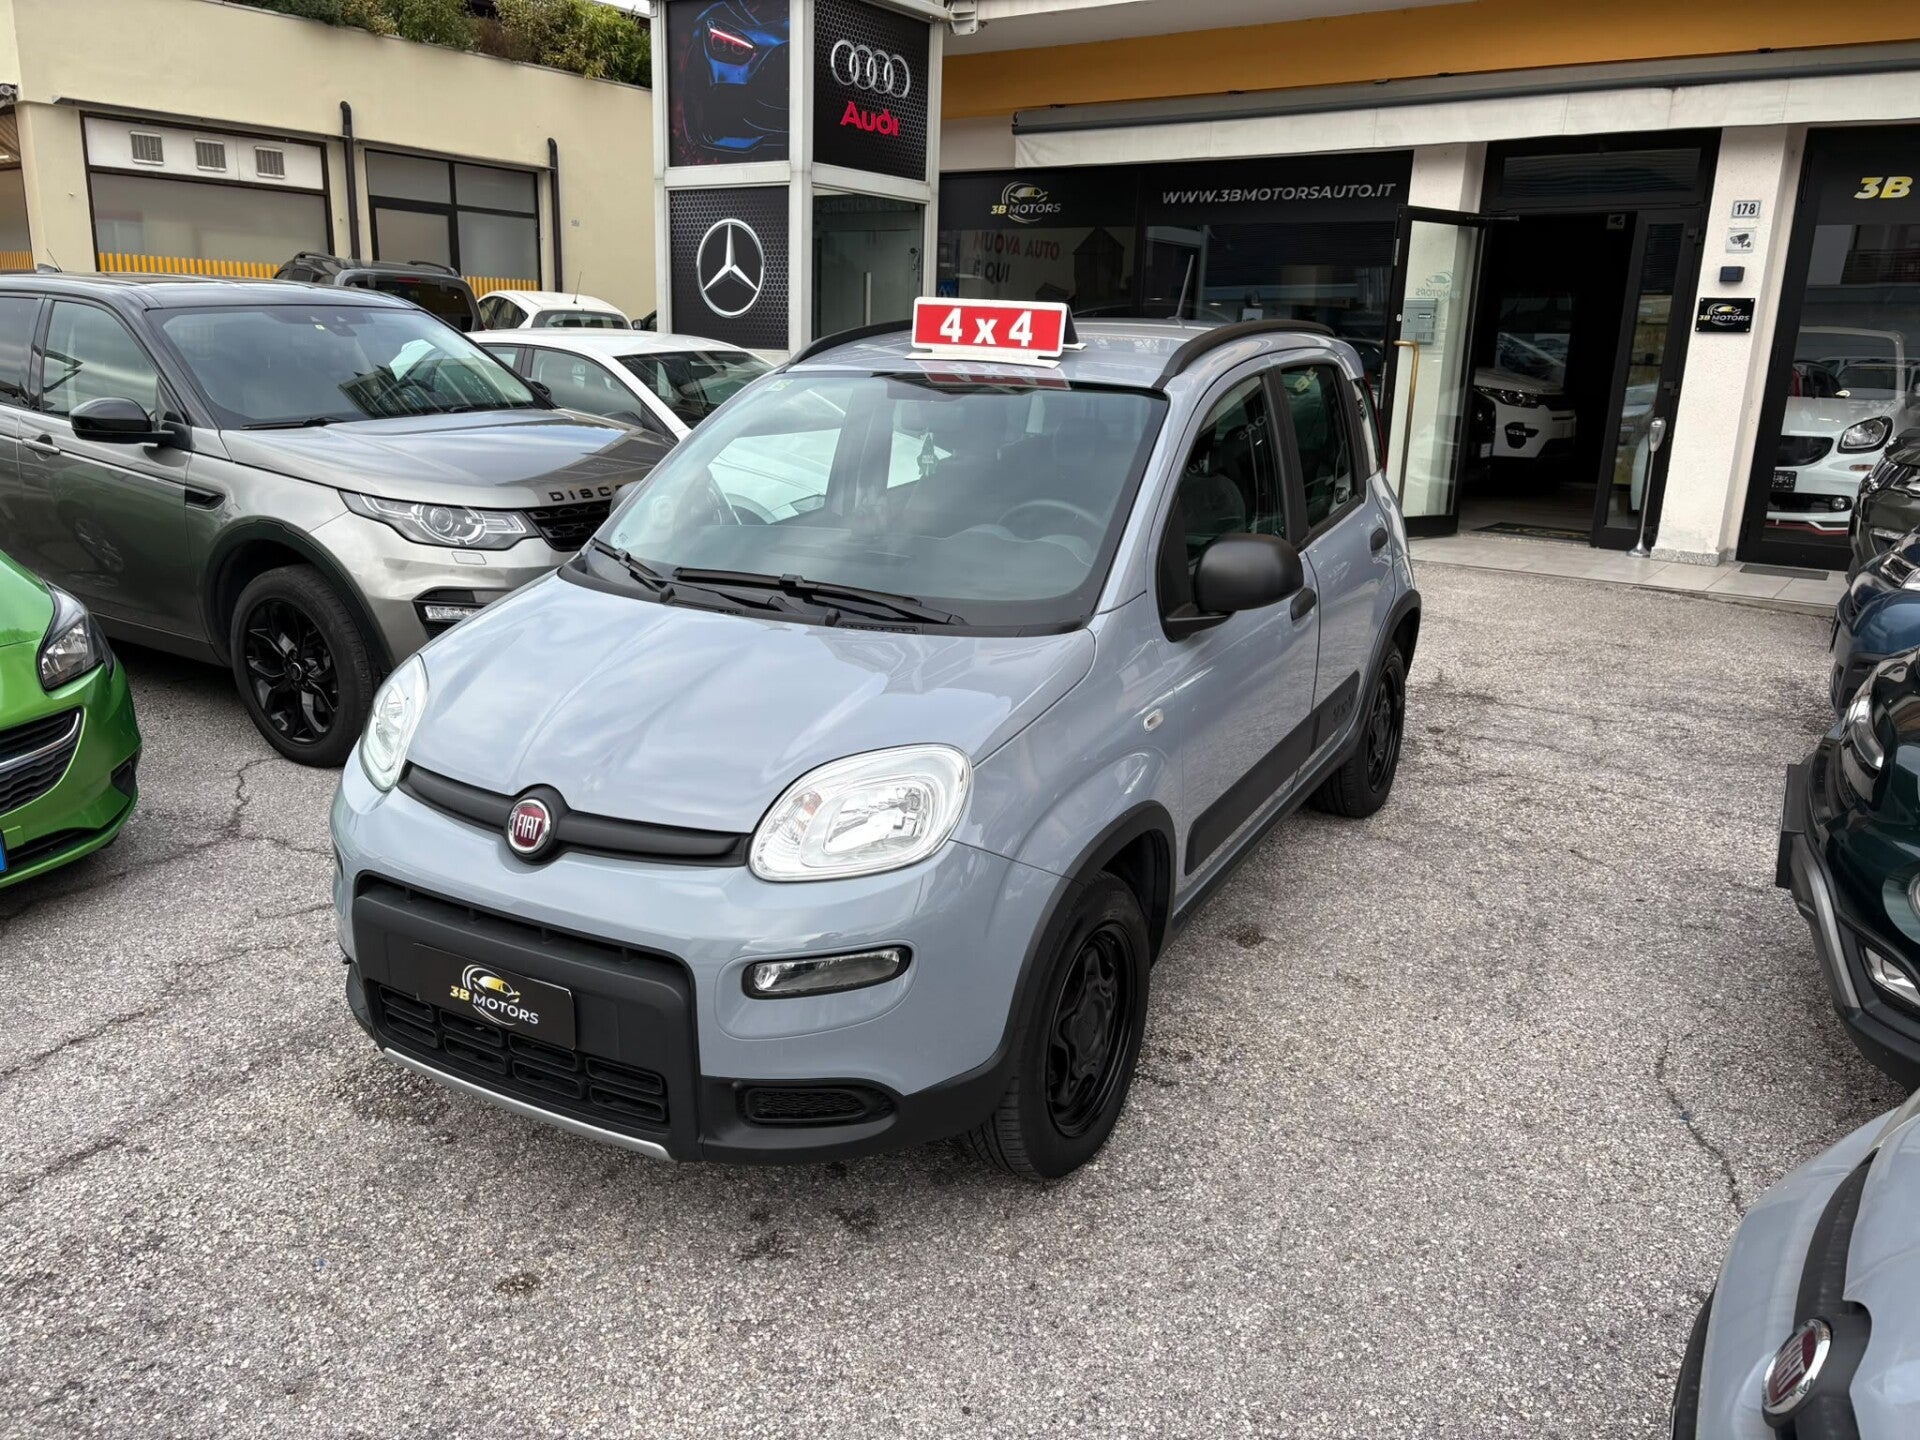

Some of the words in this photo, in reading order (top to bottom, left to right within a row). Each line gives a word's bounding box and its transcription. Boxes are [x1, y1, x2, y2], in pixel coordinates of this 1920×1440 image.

[840, 101, 899, 137] Audi
[1162, 183, 1397, 204] WWW.3BMOTORSAUTO.IT
[1854, 176, 1913, 200] 3B
[991, 205, 1007, 215] 3B
[1009, 203, 1062, 214] MOTORS
[1737, 203, 1756, 215] 178
[1024, 239, 1060, 260] AUTO
[985, 261, 1011, 284] QUI
[939, 307, 962, 343] 4
[973, 318, 998, 345] x
[1008, 310, 1033, 347] 4
[1712, 314, 1750, 322] MOTORS
[515, 814, 543, 840] FIAT
[449, 985, 471, 1002] 3B
[472, 992, 540, 1025] MOTORS
